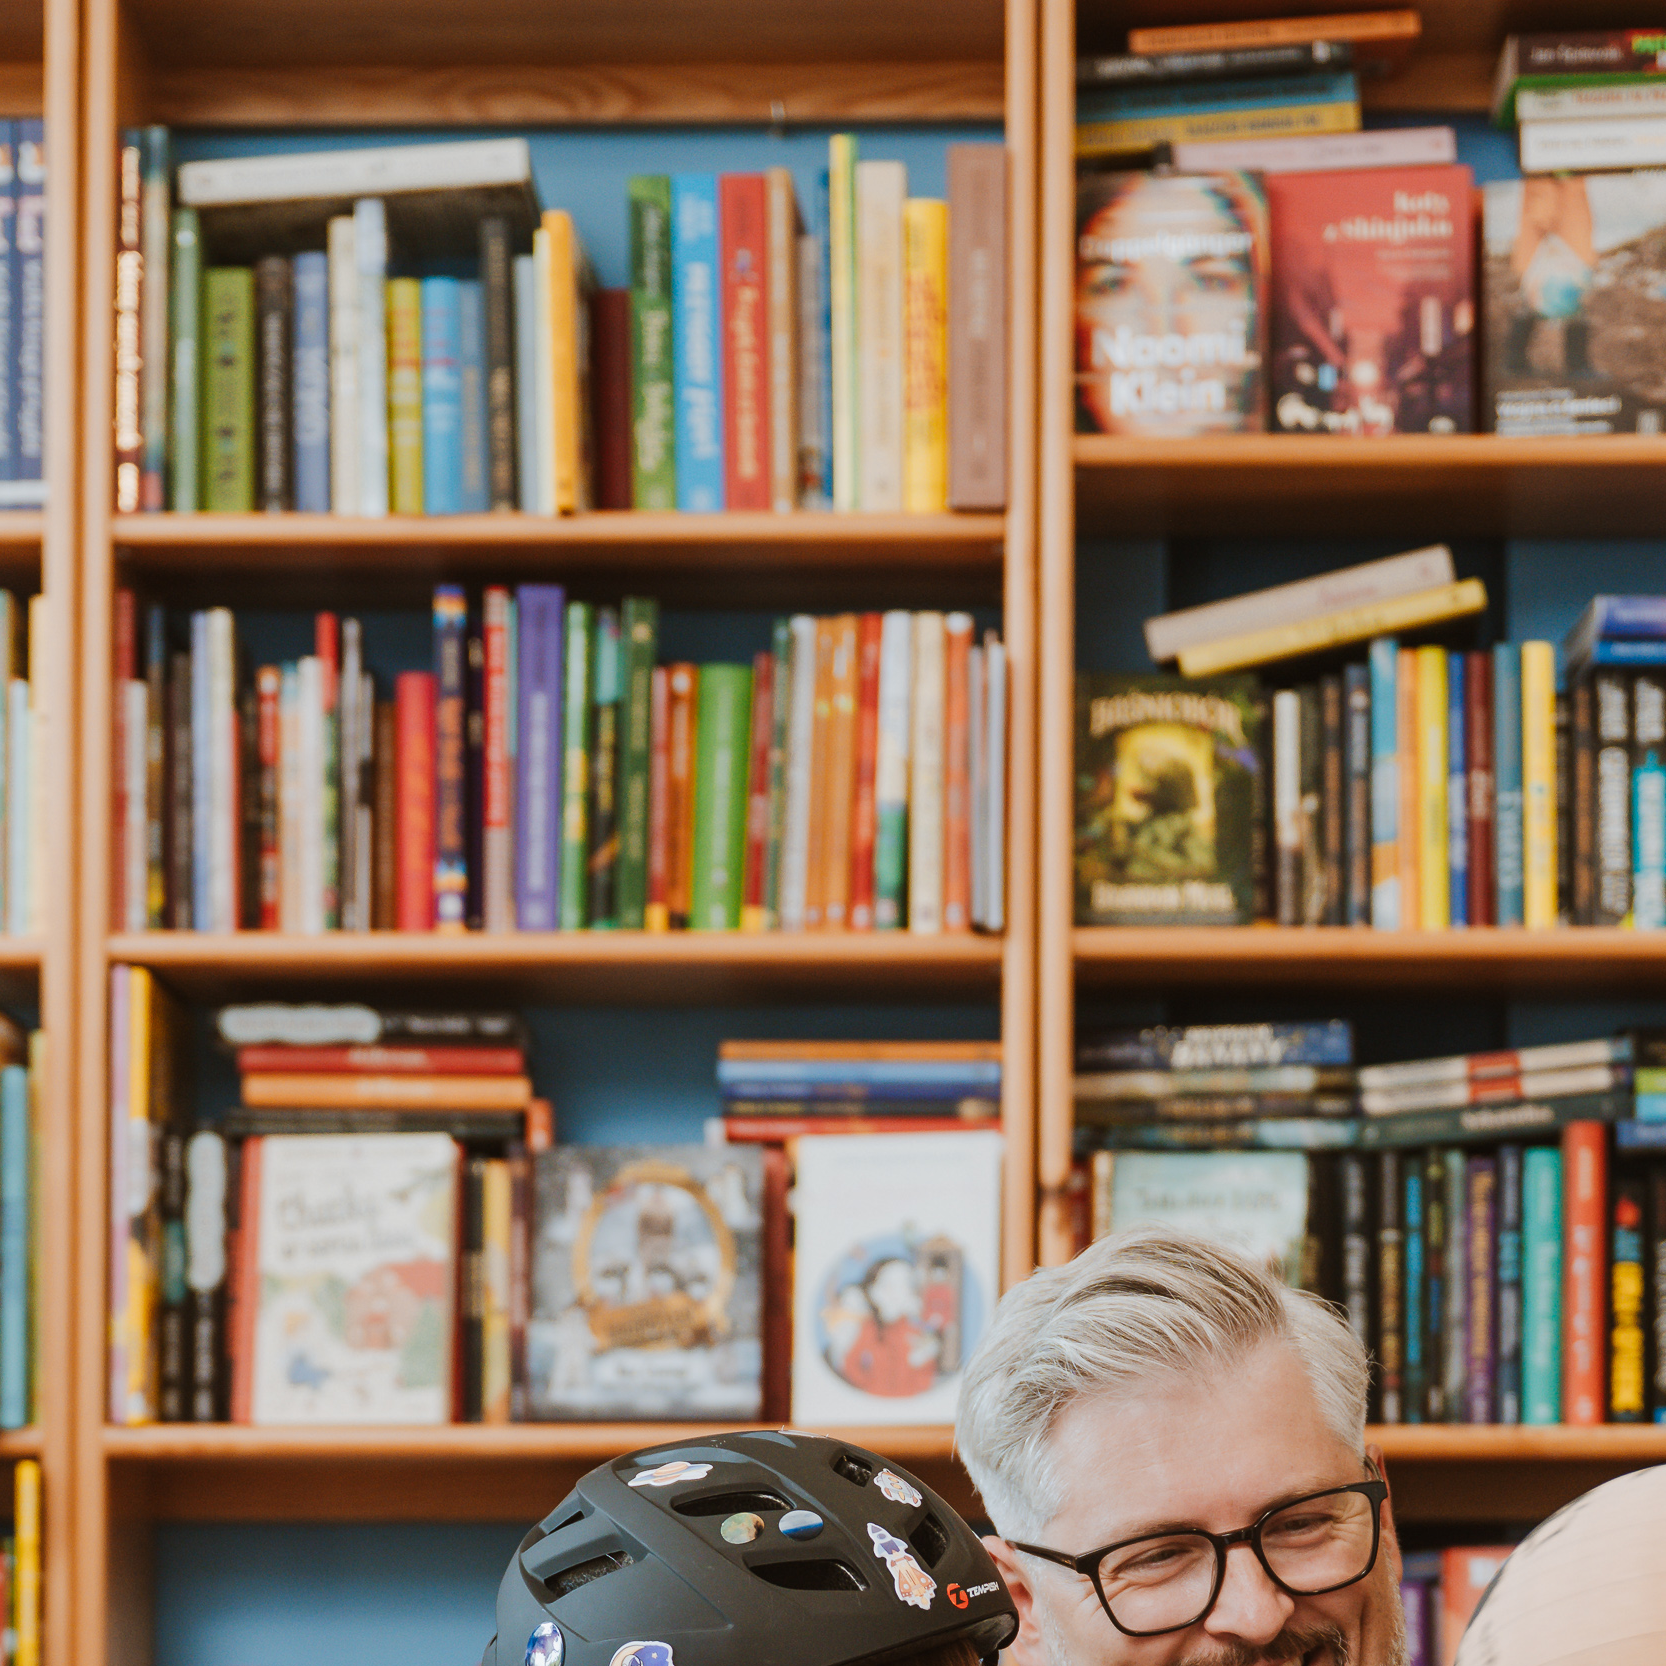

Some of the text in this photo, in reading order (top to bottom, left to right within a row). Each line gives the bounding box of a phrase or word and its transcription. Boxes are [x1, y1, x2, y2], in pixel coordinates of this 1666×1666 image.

[1092, 321, 1248, 368] Naomi
[1108, 370, 1227, 416] Klein
[966, 1581, 1000, 1598] TEMPISH
